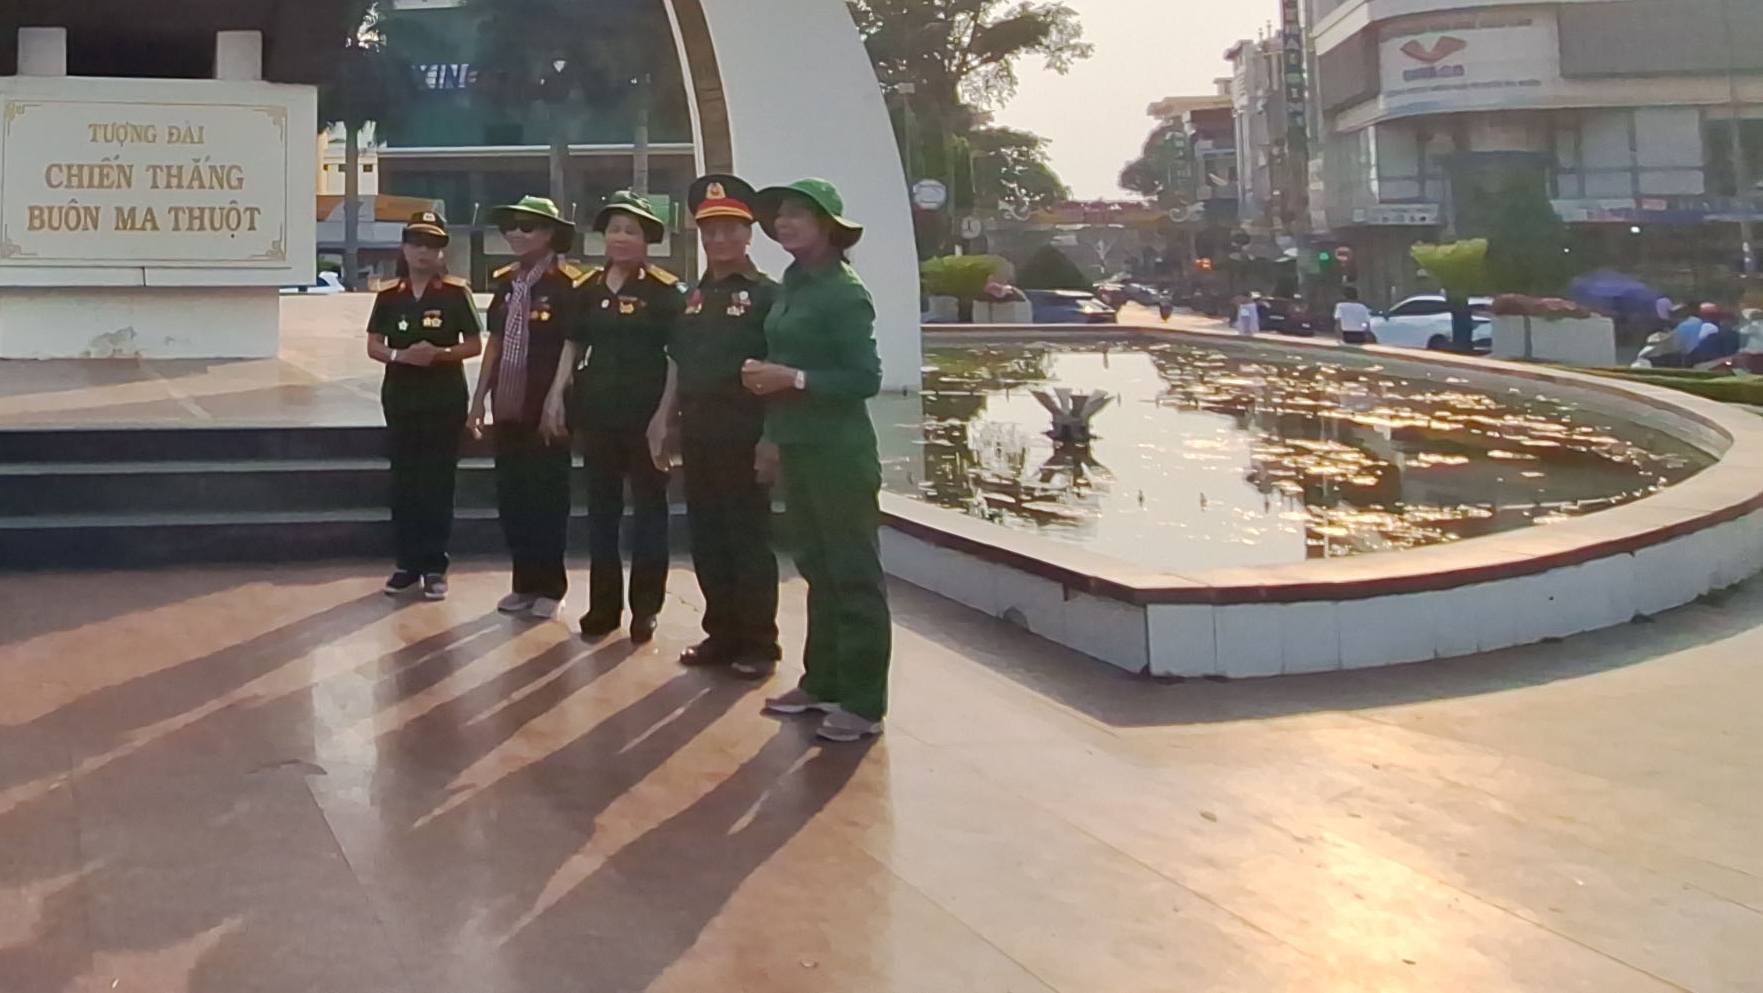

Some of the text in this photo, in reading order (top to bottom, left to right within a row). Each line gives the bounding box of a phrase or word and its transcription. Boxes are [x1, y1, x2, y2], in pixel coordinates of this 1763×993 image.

[166, 120, 205, 144] ĐÀI
[44, 154, 245, 191] CHIẾN THẮNG
[27, 199, 262, 239] BUÔN MA THUỘT
